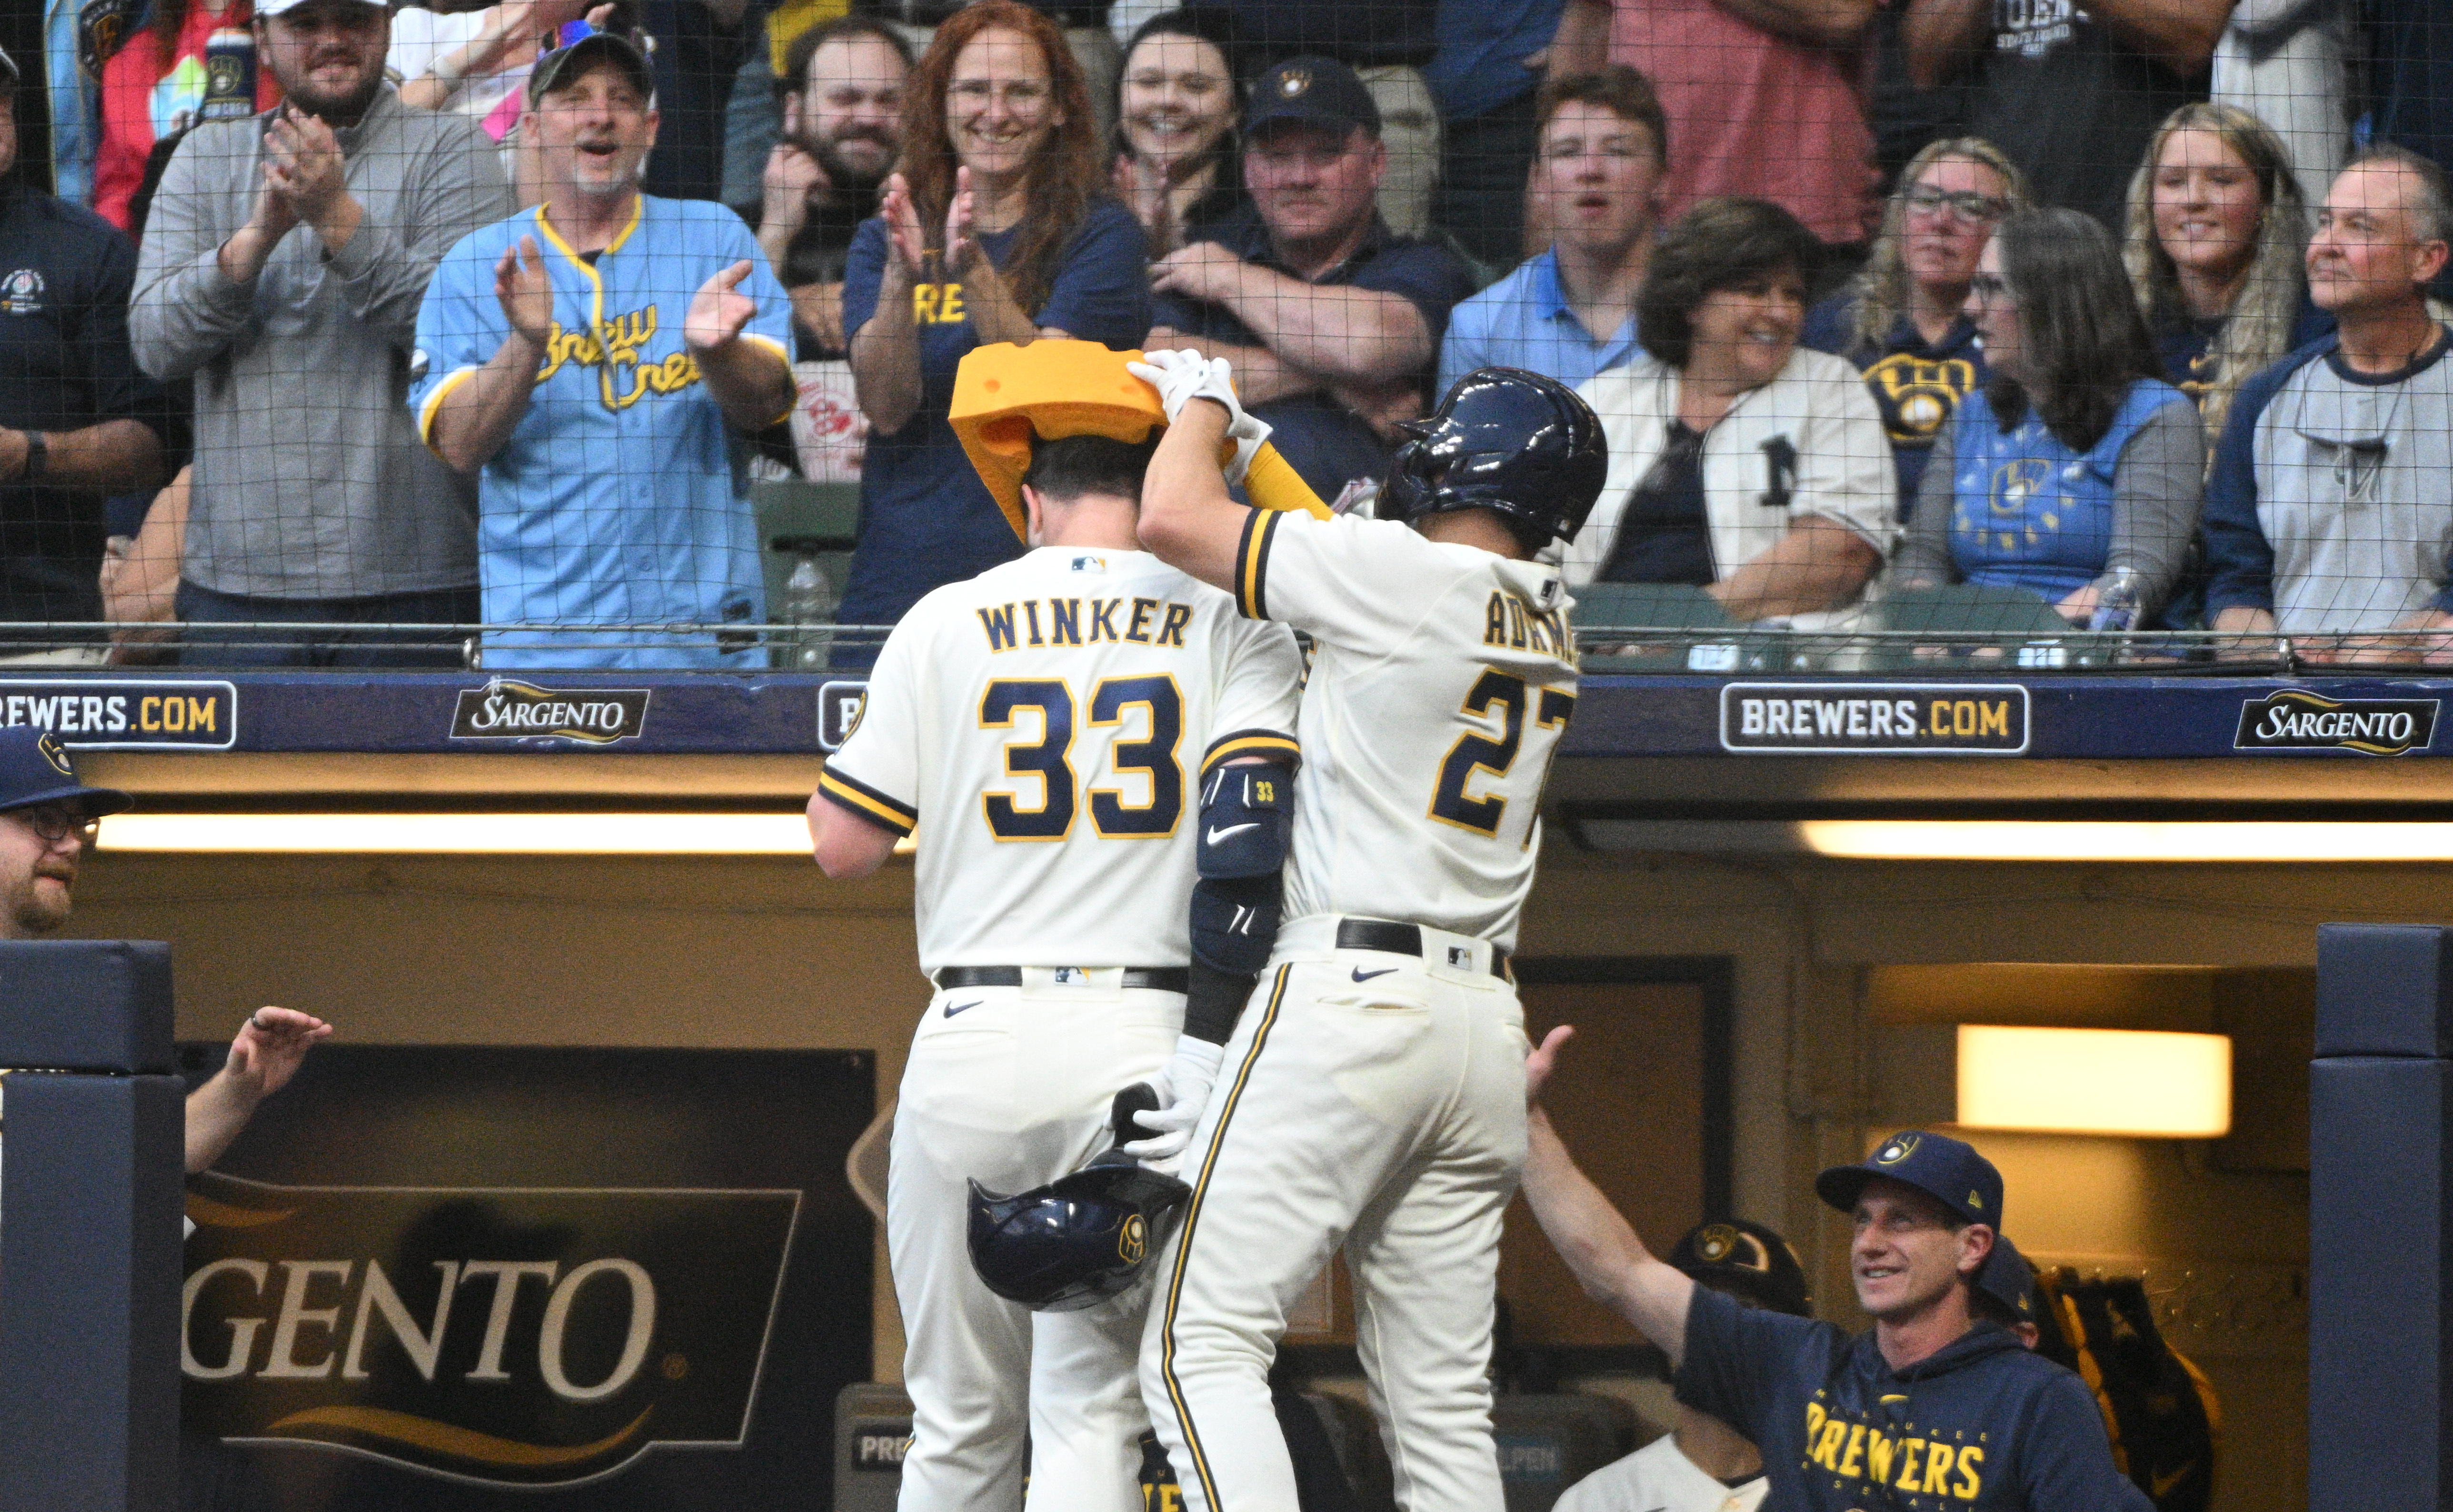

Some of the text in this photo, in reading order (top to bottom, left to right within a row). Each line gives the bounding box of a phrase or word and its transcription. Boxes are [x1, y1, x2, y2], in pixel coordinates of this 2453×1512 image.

[600, 347, 702, 414] Cre
[975, 597, 1194, 654] WINKER
[1483, 589, 1573, 666] ADAM
[0, 696, 216, 731] EWERS.COM
[471, 695, 624, 729] SARGENTO
[1741, 699, 2009, 736] BREWERS.COM
[2255, 705, 2413, 740] SARGENTO
[977, 671, 1187, 843] 33
[1256, 781, 1275, 802] 33
[1806, 1402, 1985, 1500] BREWERS
